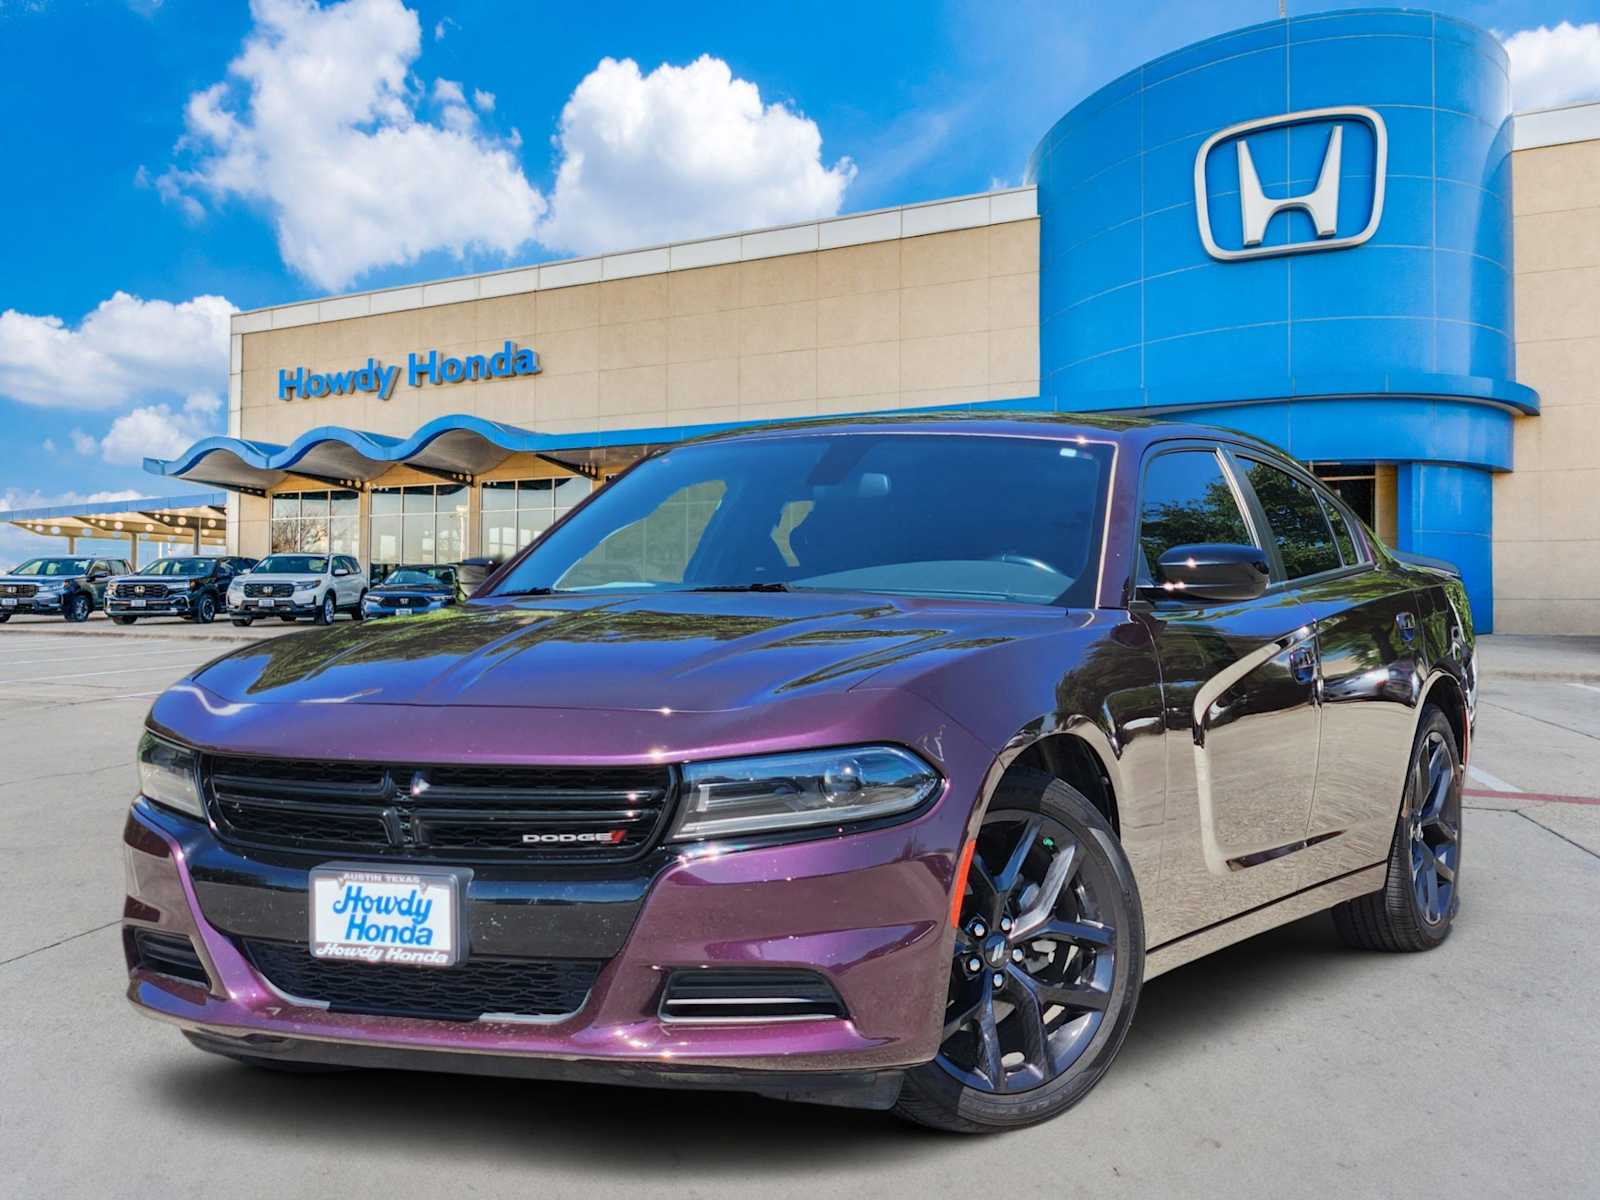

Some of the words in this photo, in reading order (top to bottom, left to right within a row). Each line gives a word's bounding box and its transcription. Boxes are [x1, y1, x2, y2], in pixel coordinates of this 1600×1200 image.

[279, 357, 400, 401] Howdy
[408, 340, 541, 387] Honda
[522, 833, 613, 843] DODGE
[342, 872, 382, 882] AUSTIN
[385, 875, 421, 884] TEXAS
[333, 885, 432, 925] Howdy
[345, 914, 433, 945] Honda
[316, 943, 384, 961] Howdy
[385, 947, 449, 964] Honda
